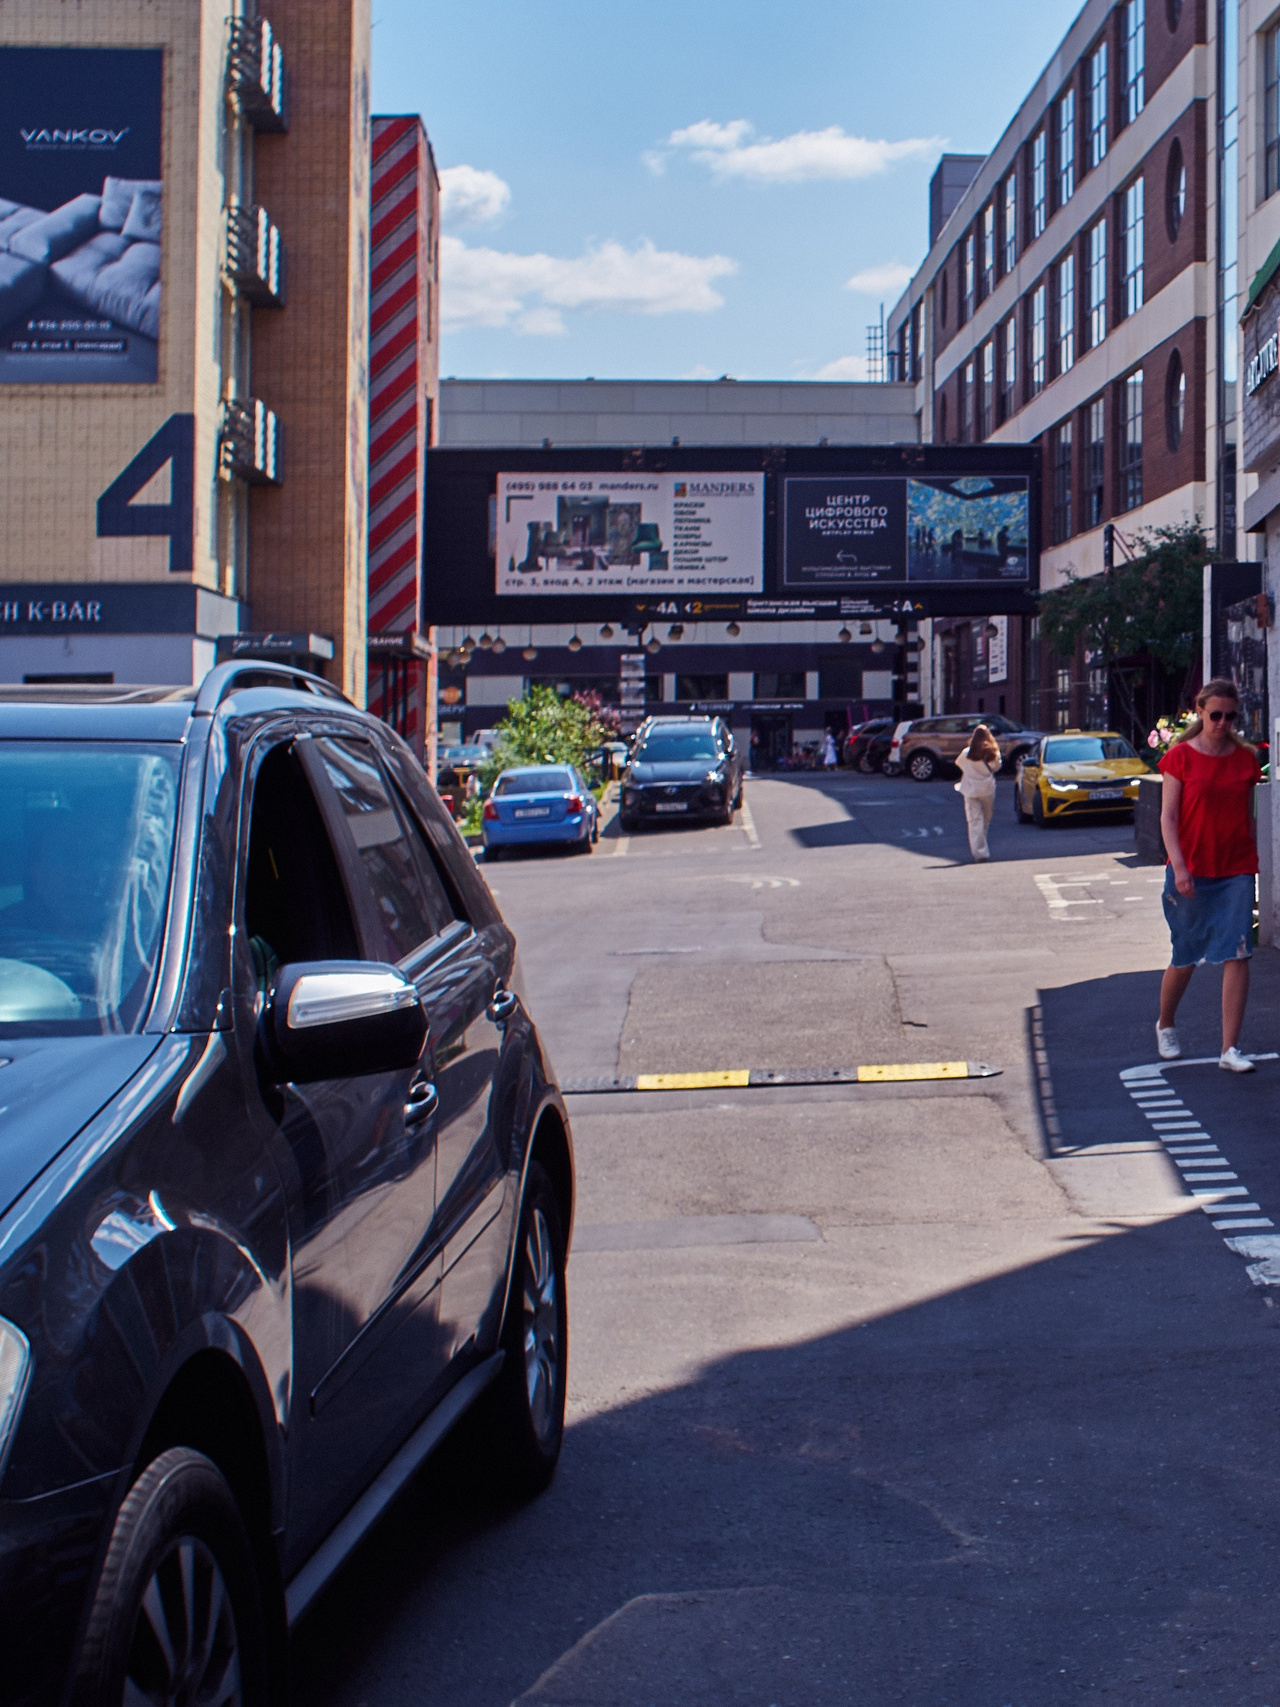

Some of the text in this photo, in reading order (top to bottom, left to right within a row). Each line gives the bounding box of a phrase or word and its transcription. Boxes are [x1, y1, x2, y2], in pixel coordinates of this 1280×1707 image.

[20, 127, 130, 144] VANKOV
[97, 413, 195, 571] 4
[599, 481, 659, 491] manders.ru
[689, 482, 755, 493] MANDERS
[826, 495, 870, 506] ЦЕНТР
[805, 506, 888, 518] ЦИФРОВОГО
[809, 518, 887, 529] ИСКУССТВА
[28, 601, 101, 622] K-BAR
[692, 601, 703, 614] 2
